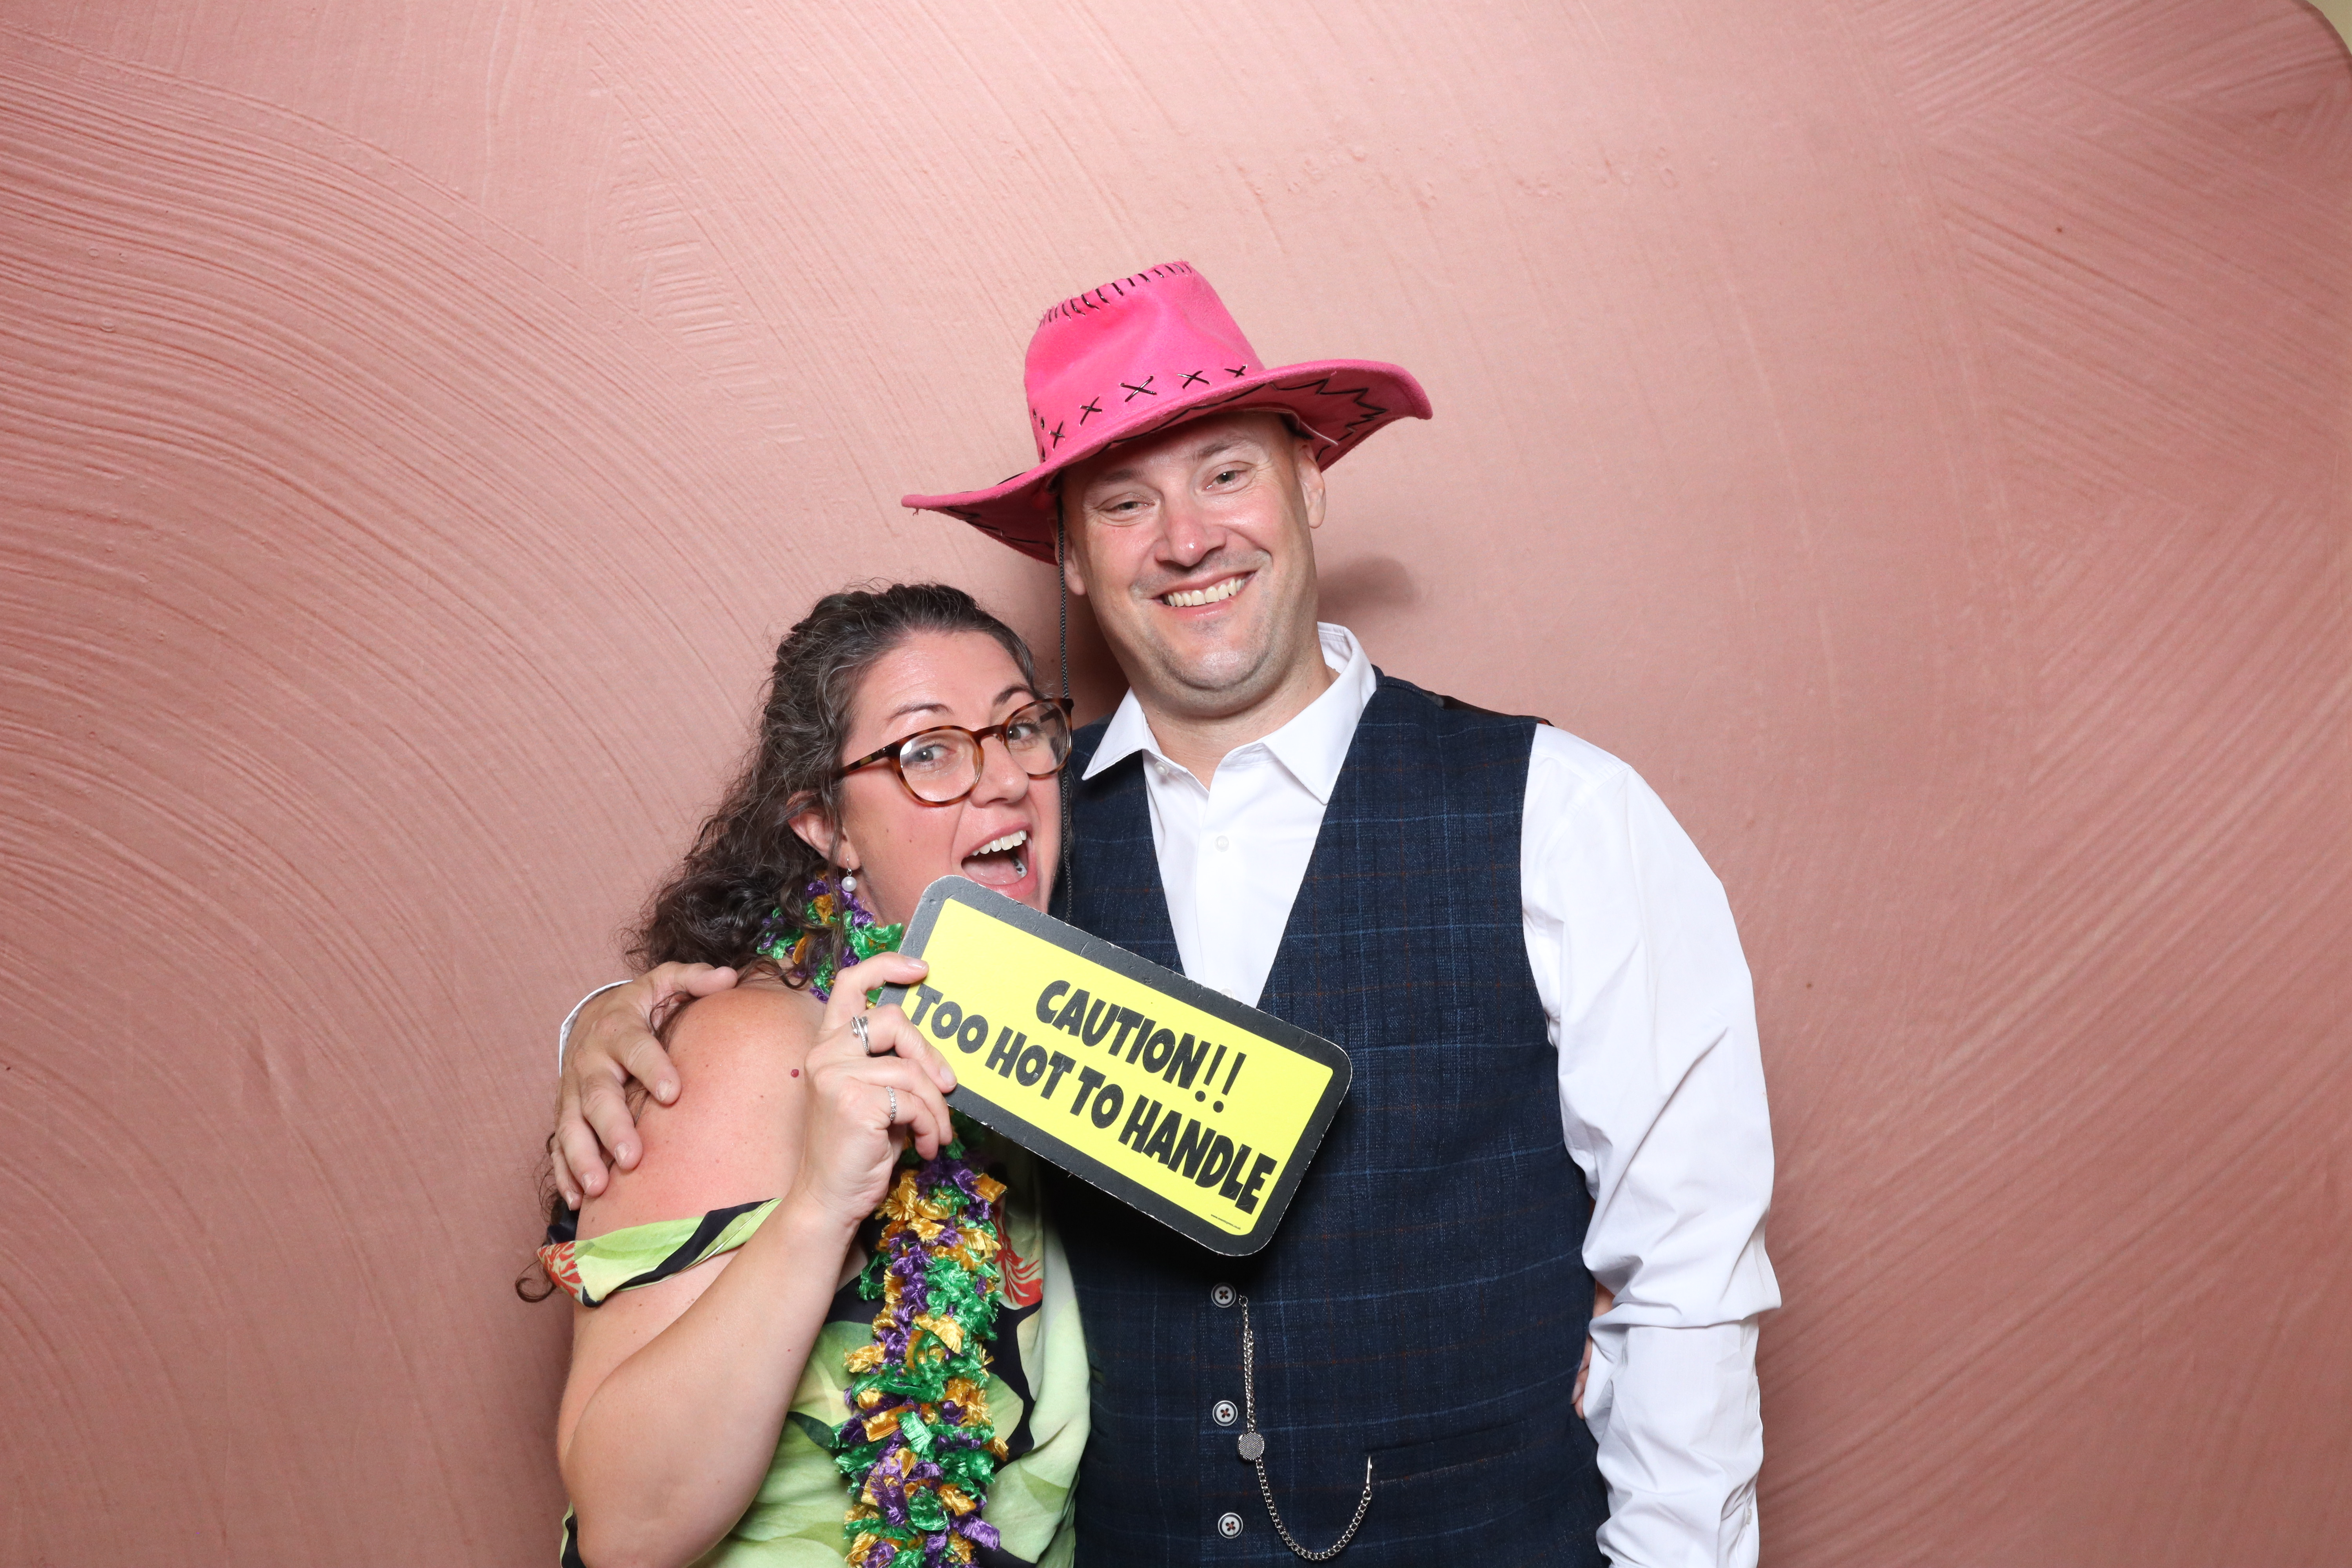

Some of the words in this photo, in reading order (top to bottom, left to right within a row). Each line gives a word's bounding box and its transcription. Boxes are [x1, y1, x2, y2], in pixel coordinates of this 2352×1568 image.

[910, 983, 988, 1054] TOO
[985, 1026, 1076, 1099] HOT
[1070, 1065, 1124, 1129] TO
[1118, 1094, 1277, 1215] HANDLE
[1036, 980, 1247, 1112] CAUTION!!
